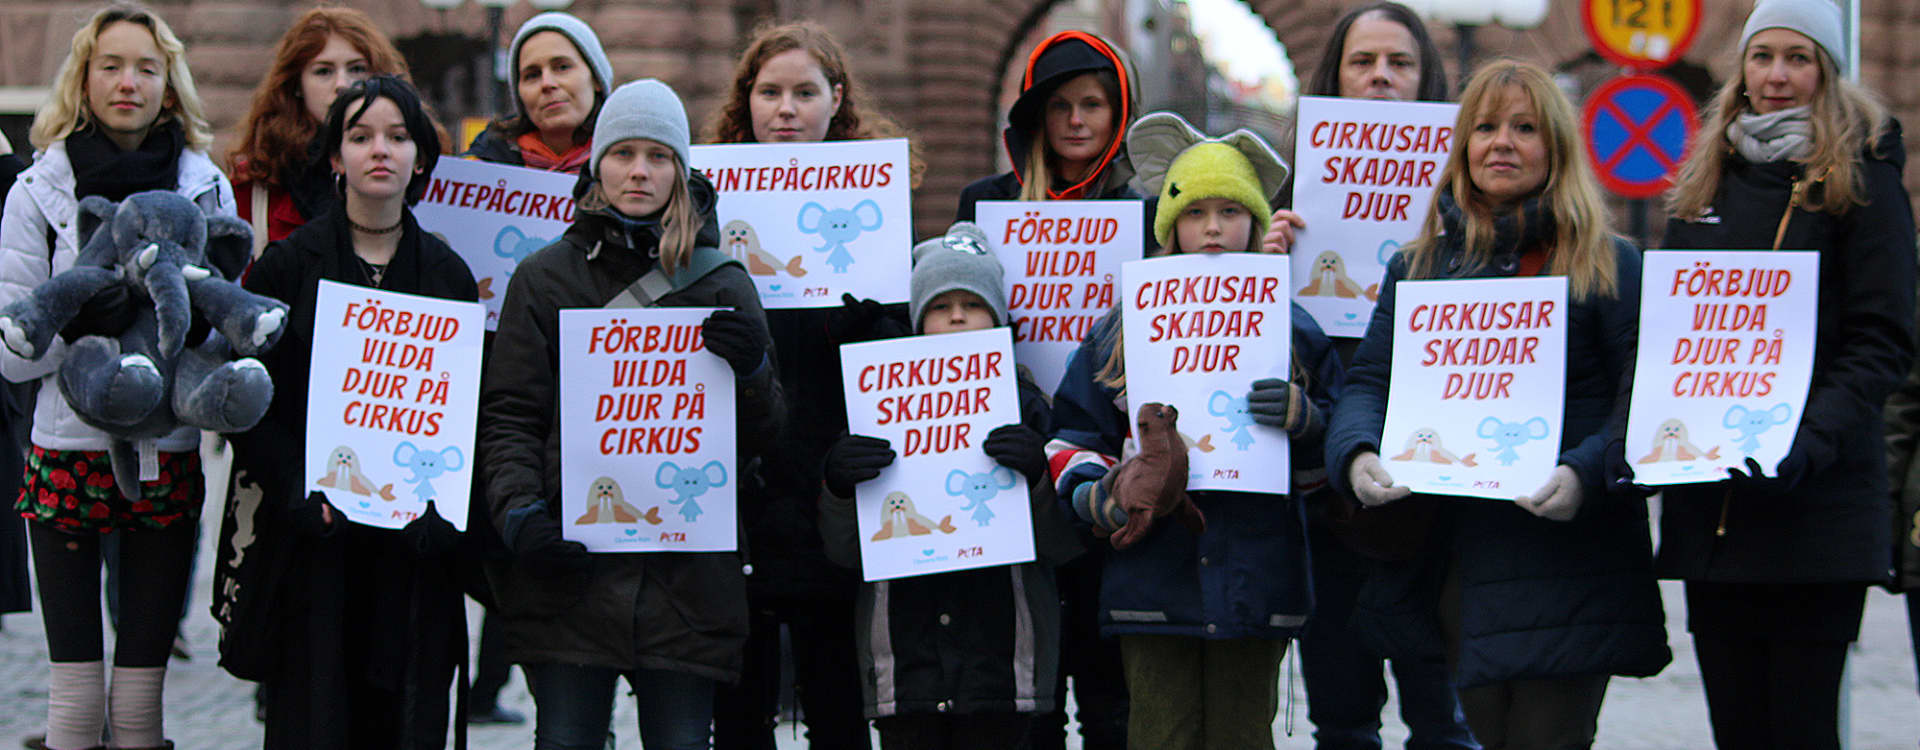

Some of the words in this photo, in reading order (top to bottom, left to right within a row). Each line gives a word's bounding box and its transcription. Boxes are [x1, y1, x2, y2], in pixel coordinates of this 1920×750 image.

[1310, 121, 1454, 153] CIRKUSAR
[1321, 156, 1436, 188] SKADAR
[1341, 191, 1412, 222] DJUR
[1003, 211, 1118, 245] FÖRBJUD
[1026, 250, 1096, 278] VILDA
[1670, 261, 1791, 297] FÖRBJUD
[1008, 283, 1073, 311] DJUR
[1081, 273, 1115, 310] PÅ
[1135, 275, 1279, 311] CIRKUSAR
[342, 298, 460, 342] FÖRBJUD
[1015, 315, 1102, 344] CIRKU
[1149, 309, 1264, 343] SKADAR
[1408, 300, 1555, 333] CIRKUSAR
[1692, 303, 1767, 331] VILDA
[362, 338, 435, 372] VILDA
[1170, 343, 1240, 375] DJUR
[1420, 336, 1539, 367] SKADAR
[1671, 337, 1740, 365] DJUR
[1748, 328, 1785, 365] PÅ
[342, 367, 408, 400] DJUR
[415, 371, 450, 406] PÅ
[612, 359, 687, 388] VILDA
[858, 351, 1002, 394] CIRKUSAR
[1441, 372, 1514, 400] DJUR
[1672, 371, 1777, 398] CIRKUS
[343, 401, 444, 437] CIRKUS
[595, 393, 663, 422] DJUR
[672, 383, 705, 421] PÅ
[876, 387, 991, 426] SKADAR
[599, 426, 703, 456] CIRKUS
[903, 422, 971, 458] DJUR
